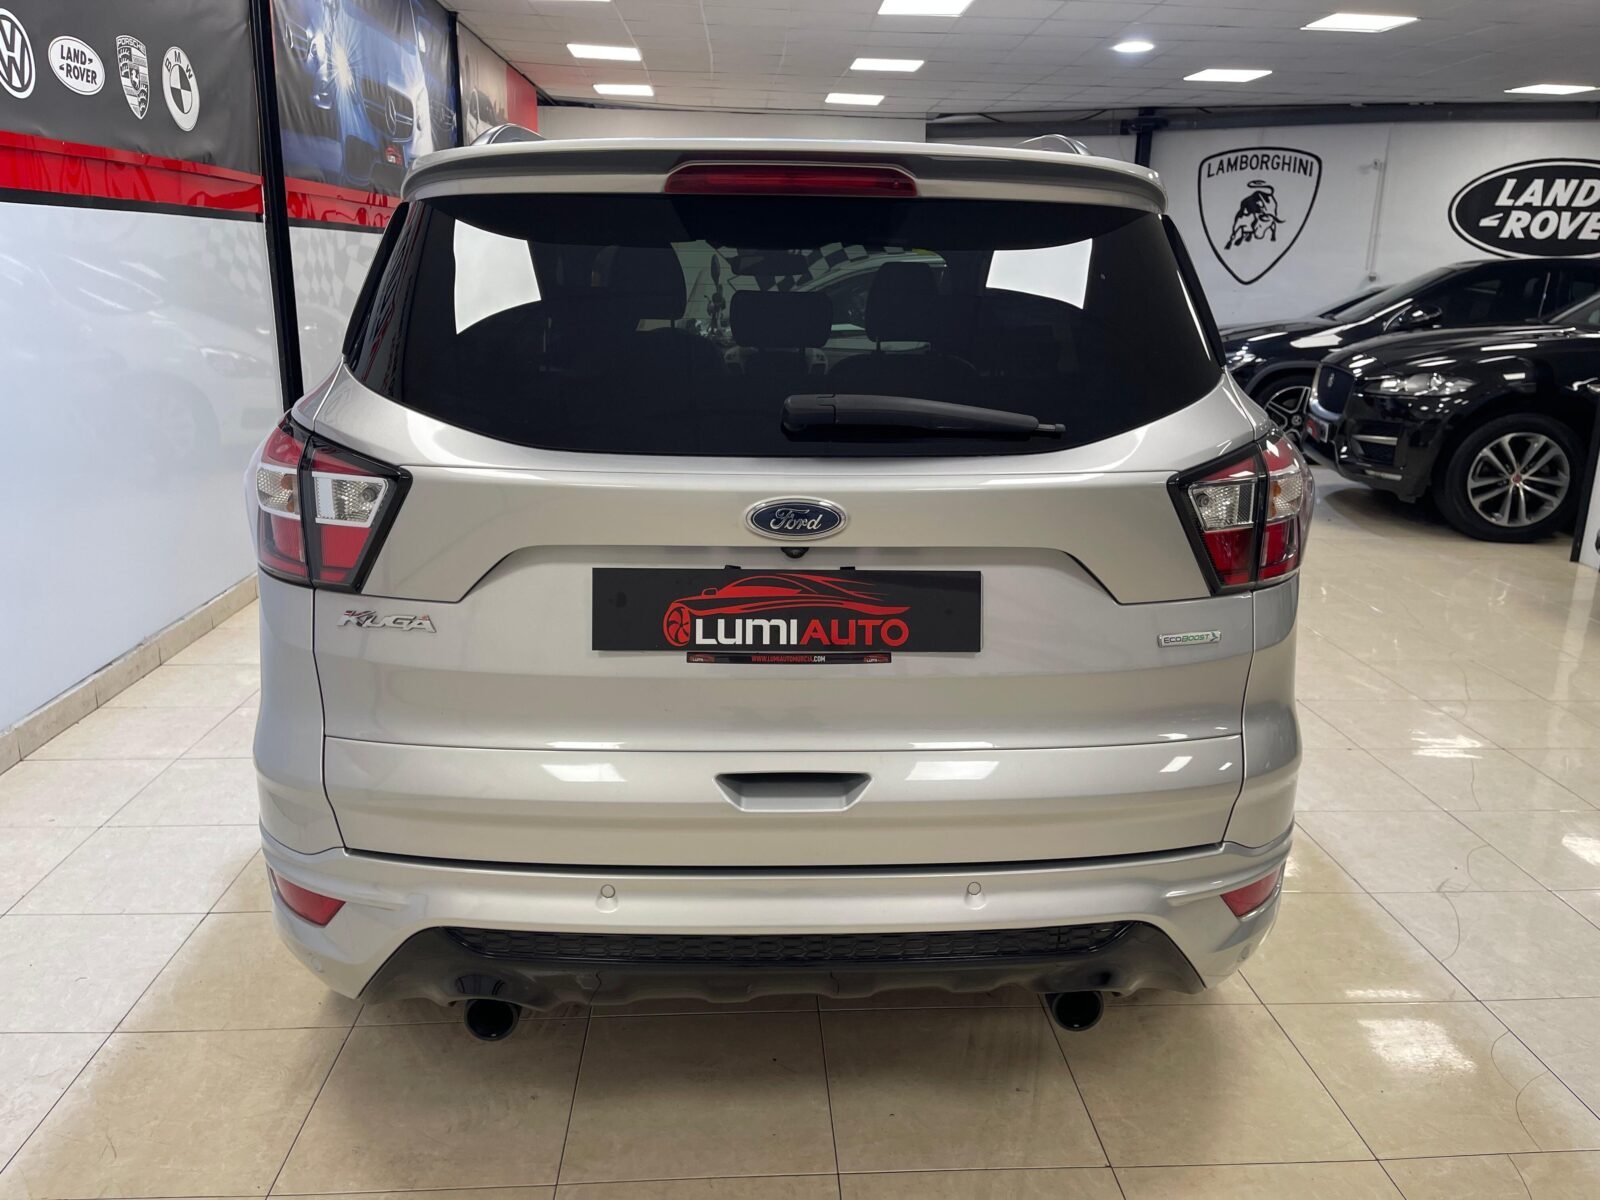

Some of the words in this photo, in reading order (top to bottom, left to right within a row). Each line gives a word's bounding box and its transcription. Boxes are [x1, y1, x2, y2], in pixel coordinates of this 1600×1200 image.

[60, 45, 87, 65] LAND
[117, 37, 146, 53] PORSCHE
[66, 64, 98, 86] ROVER
[165, 50, 193, 79] BMW
[1206, 154, 1314, 178] LAMBORGHINI
[1494, 178, 1600, 207] LAND
[1498, 210, 1600, 240] ROVE
[770, 507, 824, 530] Ford
[336, 609, 437, 634] KUGA
[1163, 633, 1210, 643] ECOBOOST
